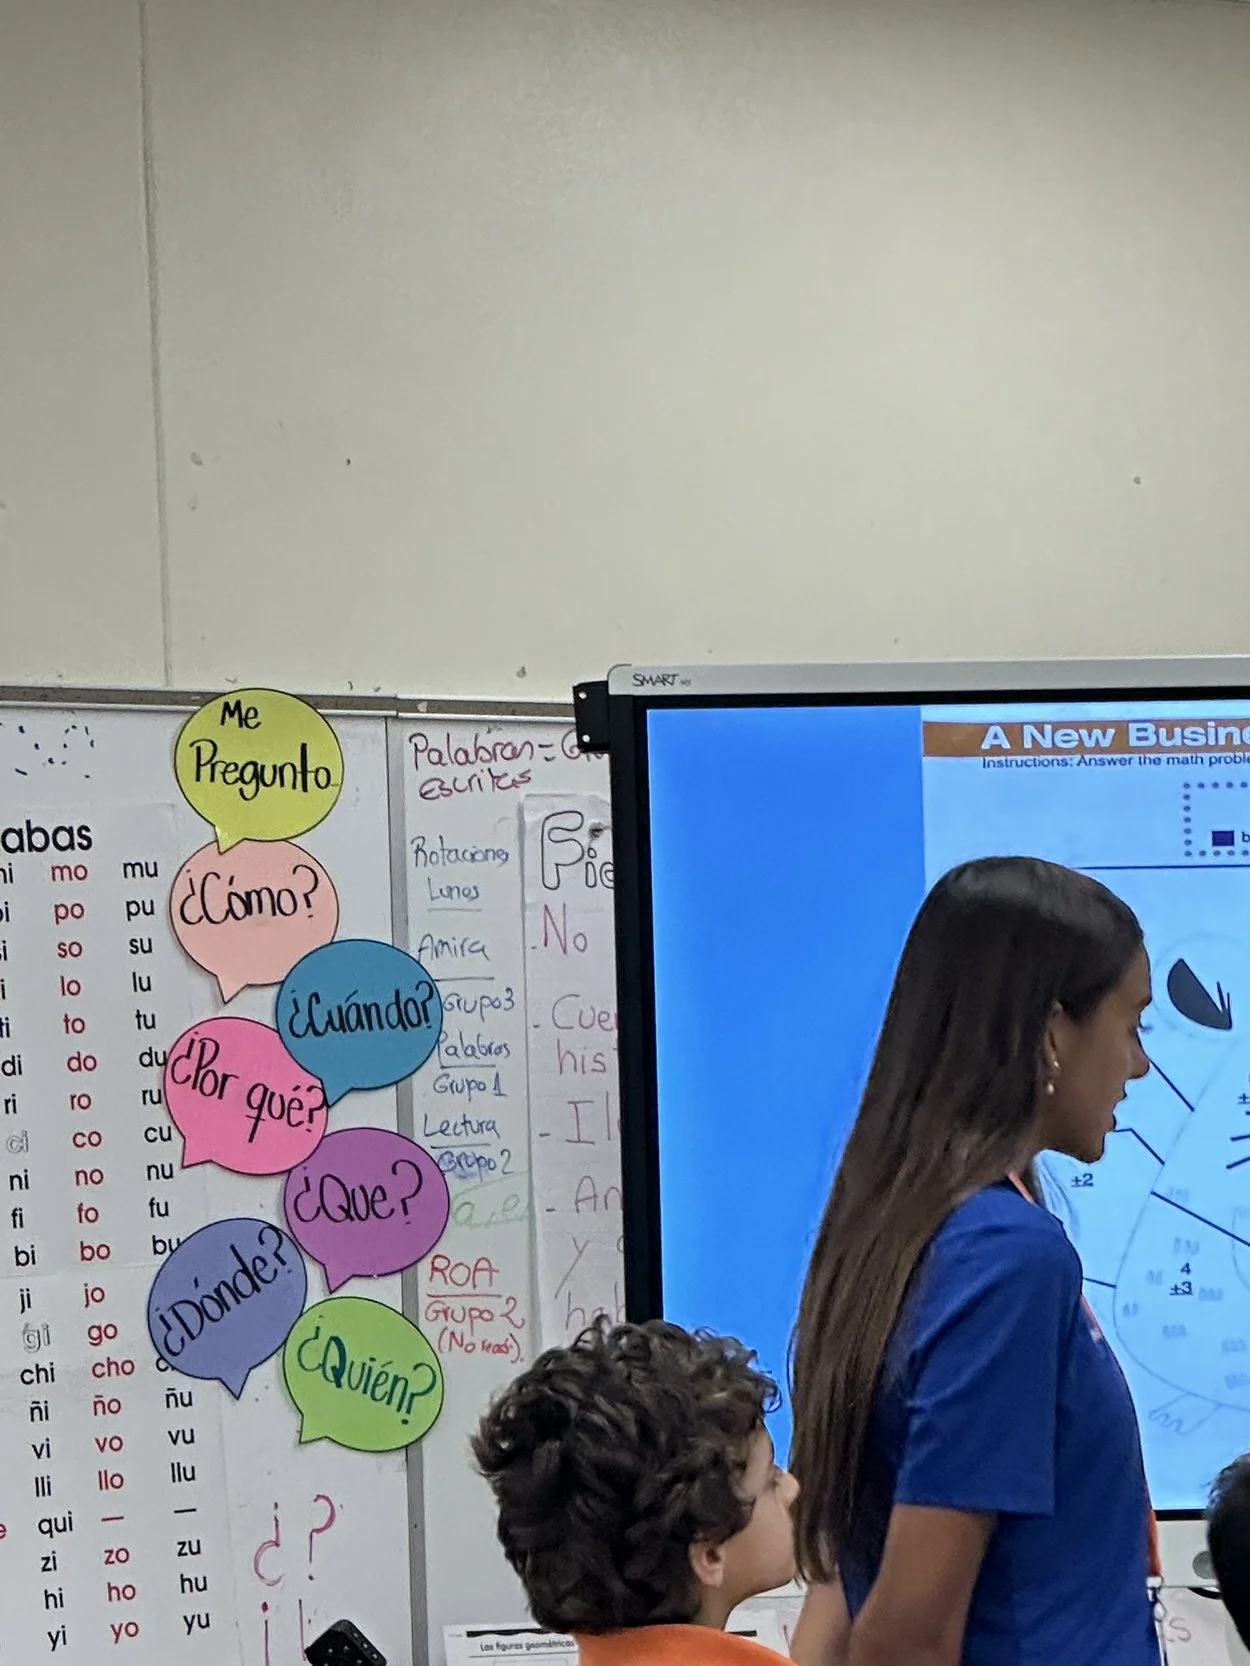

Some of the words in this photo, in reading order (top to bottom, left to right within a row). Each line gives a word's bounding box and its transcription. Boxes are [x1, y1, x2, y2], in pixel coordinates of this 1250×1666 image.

[632, 673, 679, 686] SMART
[220, 699, 261, 729] Me
[981, 725, 1011, 750] A
[1023, 724, 1115, 749] New
[189, 738, 332, 801] Pregunto
[982, 756, 1073, 770] Instructions:
[1077, 755, 1132, 767] Answer
[1139, 754, 1161, 766] the
[1166, 754, 1203, 766] math
[0, 820, 92, 853] abas
[51, 864, 88, 881] mo
[123, 861, 158, 878] mu
[179, 865, 319, 925] ¿Cómo?
[54, 902, 85, 925] po
[126, 899, 155, 921] pu
[544, 902, 588, 955] No
[57, 942, 82, 958] so
[129, 937, 152, 954] su
[60, 976, 81, 996] lo
[132, 971, 152, 992] lu
[63, 1013, 86, 1034] to
[135, 1009, 156, 1030] tu
[288, 980, 434, 1038] ¿Cuándo?
[552, 994, 618, 1032] Cue
[1, 1055, 23, 1076] di
[67, 1051, 97, 1072] do
[139, 1047, 167, 1068] du
[557, 1039, 617, 1075] his
[3, 1094, 17, 1114] ri
[70, 1092, 92, 1110] ro
[141, 1088, 162, 1106] ru
[171, 1032, 239, 1099] ¿Por
[246, 1086, 325, 1143] qué?
[433, 1073, 486, 1102] Grupo
[493, 1071, 507, 1097] 1
[7, 1131, 29, 1153] ci
[72, 1131, 102, 1148] co
[144, 1125, 172, 1142] cu
[424, 1113, 500, 1139] Lectura
[9, 1169, 29, 1190] ni
[75, 1168, 104, 1186] no
[147, 1163, 173, 1181] nu
[501, 1149, 515, 1175] 2
[294, 1158, 423, 1224] ¿Que?
[11, 1207, 24, 1229] fi
[77, 1203, 99, 1223] fo
[149, 1197, 169, 1218] fu
[14, 1245, 36, 1267] bi
[79, 1241, 110, 1261] bo
[152, 1235, 180, 1256] bu
[429, 1254, 500, 1290] ROA
[1180, 1263, 1192, 1276] 4
[19, 1288, 31, 1314] ji
[84, 1283, 105, 1308] jo
[156, 1224, 292, 1357] ¿Dónde?
[425, 1300, 494, 1337] Grupo
[87, 1323, 117, 1346] go
[20, 1362, 55, 1385] chi
[91, 1357, 135, 1379] cho
[298, 1315, 436, 1425] ¿Quién?
[30, 1400, 49, 1422] ñi
[93, 1395, 121, 1416] ño
[165, 1388, 193, 1409] ñu
[32, 1438, 50, 1459] vi
[95, 1435, 123, 1453] vo
[168, 1428, 195, 1446] vu
[35, 1475, 51, 1497] lli
[98, 1470, 124, 1491] llo
[170, 1462, 196, 1483] llu
[38, 1511, 73, 1538] qui
[41, 1551, 57, 1572] zi
[104, 1548, 130, 1565] zo
[177, 1539, 201, 1557] zu
[44, 1588, 64, 1610] hi
[107, 1582, 136, 1602] ho
[180, 1574, 208, 1594] hu
[47, 1625, 66, 1651] yi
[110, 1622, 139, 1644] yo
[183, 1612, 210, 1635] yu
